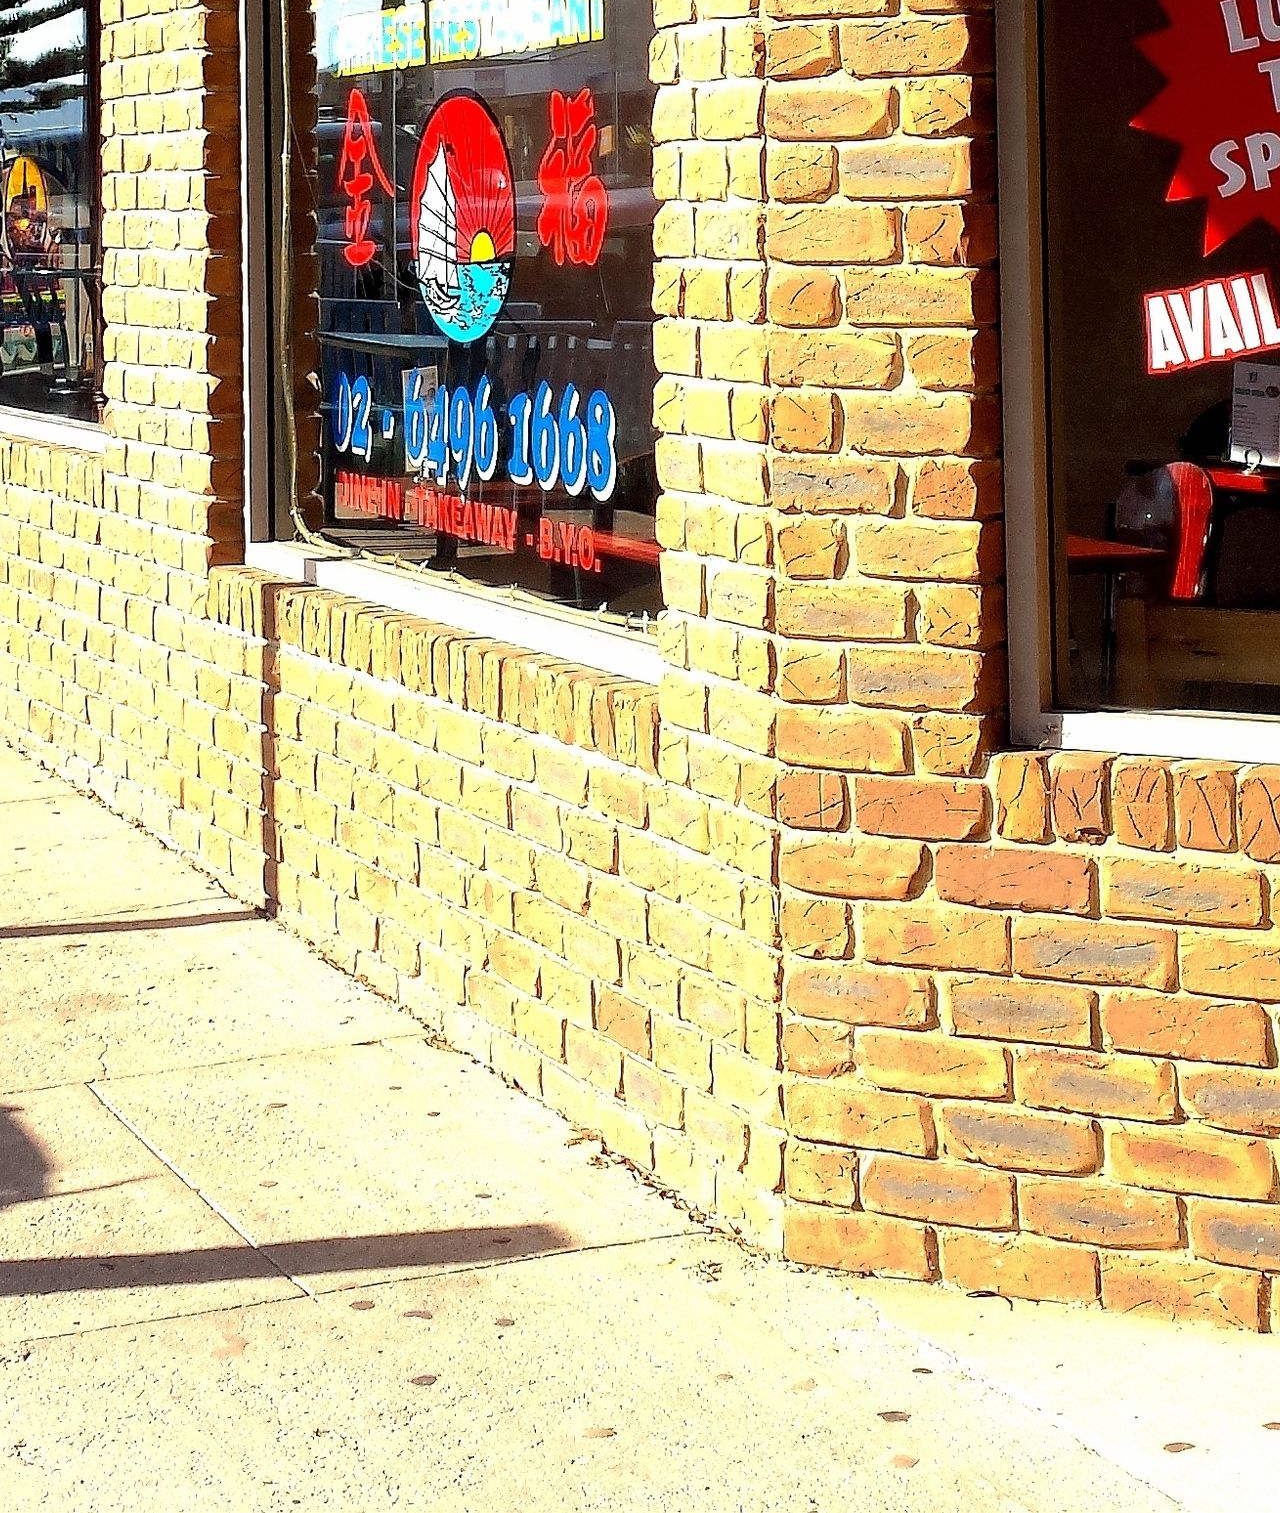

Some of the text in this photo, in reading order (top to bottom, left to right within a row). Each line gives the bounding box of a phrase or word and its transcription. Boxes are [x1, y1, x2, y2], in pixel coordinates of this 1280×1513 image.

[335, 371, 372, 463] 02
[404, 367, 498, 491] 6496
[508, 379, 617, 503] 1668
[414, 486, 518, 551] TAKEAWAY
